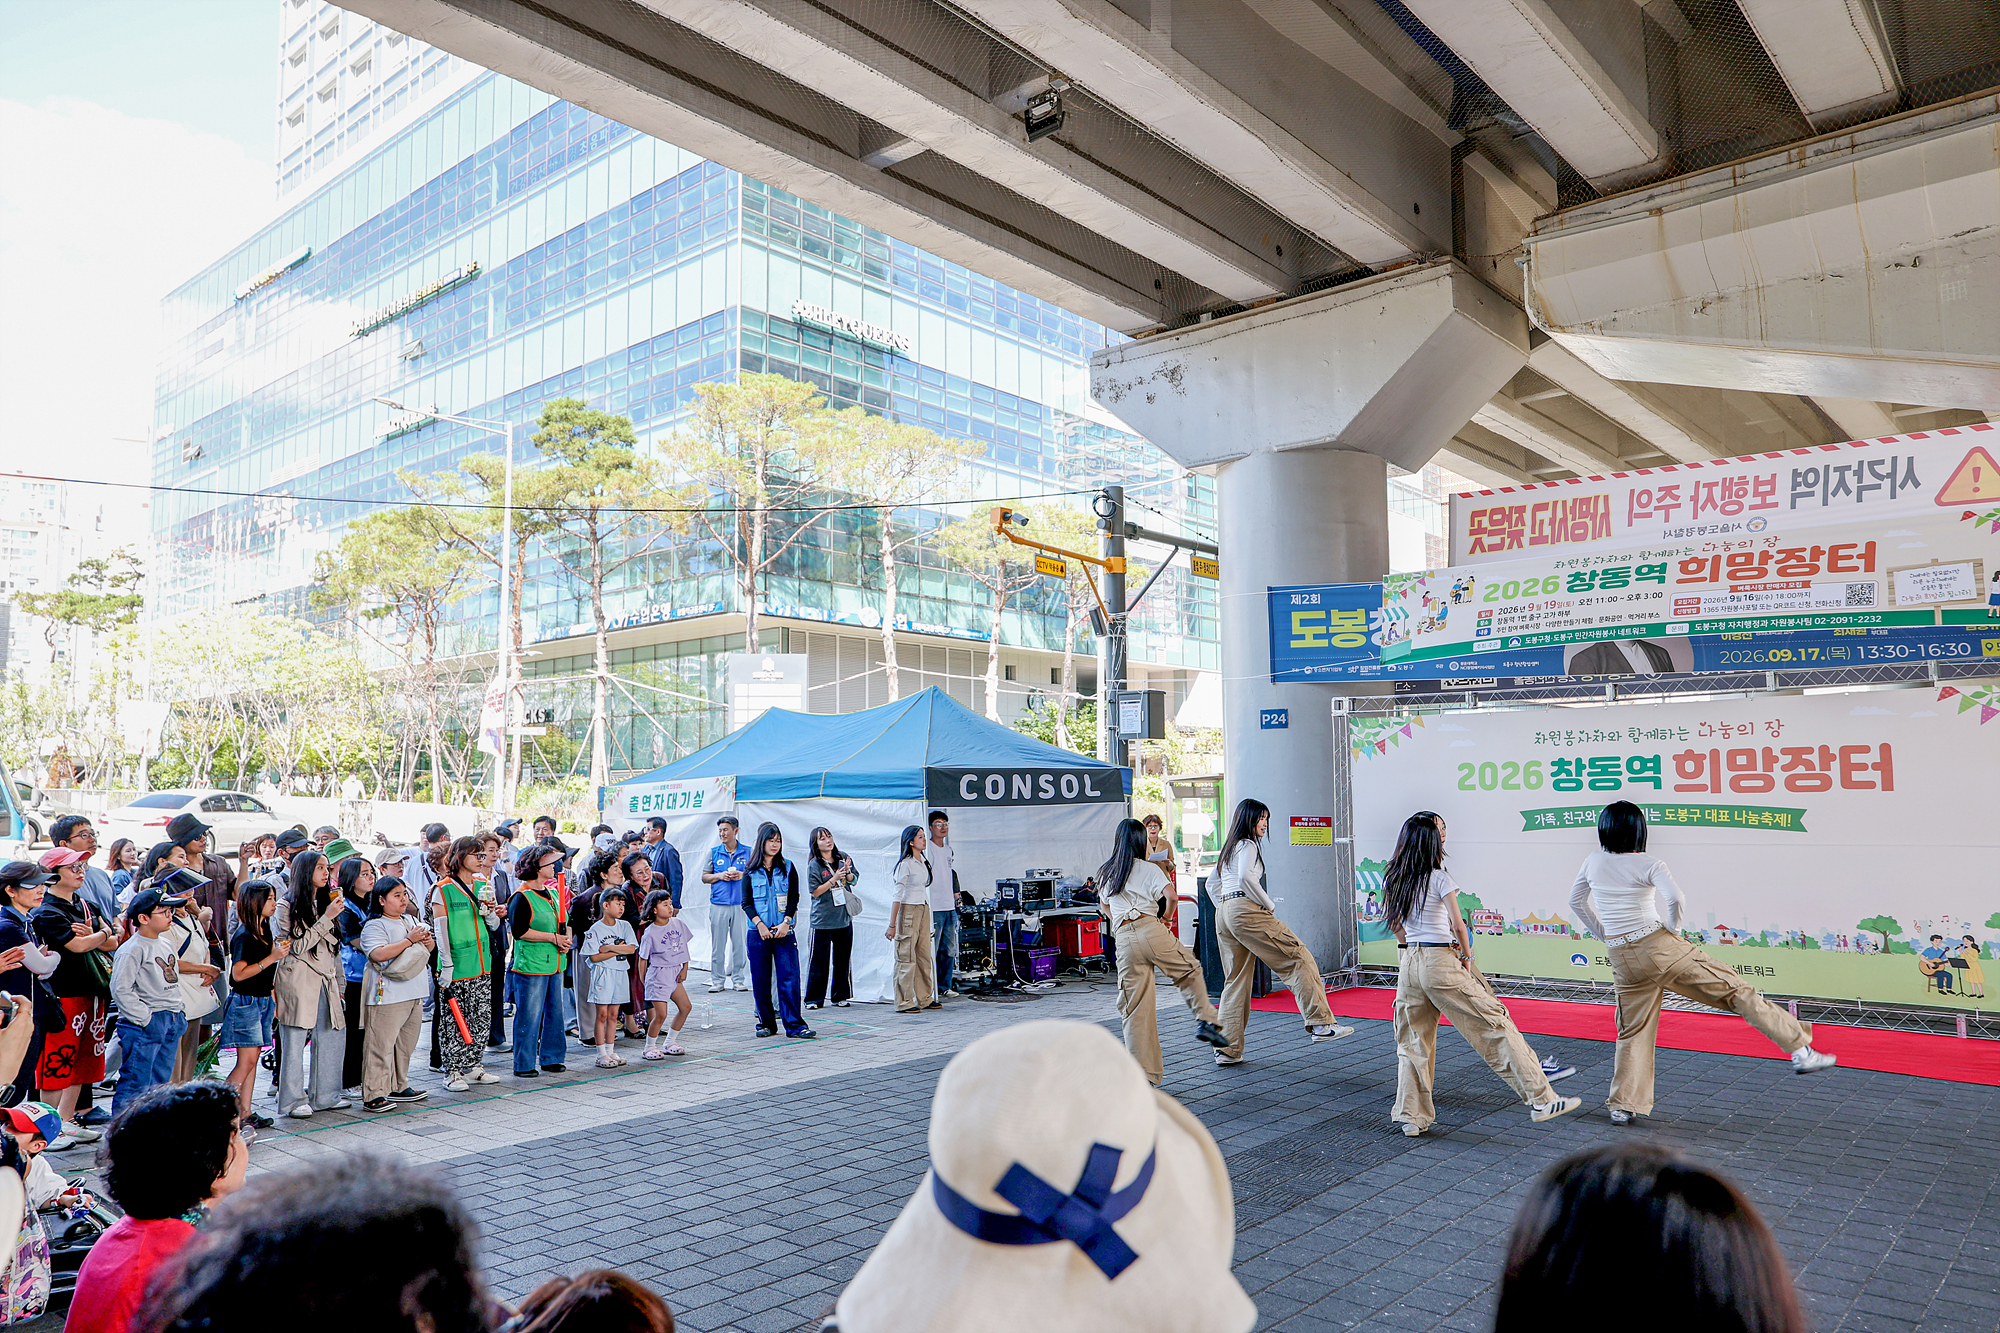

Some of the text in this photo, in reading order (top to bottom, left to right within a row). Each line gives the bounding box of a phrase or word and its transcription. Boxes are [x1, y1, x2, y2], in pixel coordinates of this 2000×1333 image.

[850, 318, 911, 352] QUEENS
[1639, 546, 1695, 561] 함께하는
[1702, 540, 1753, 552] 나눔의
[1763, 536, 1781, 547] 장
[1483, 541, 1877, 602] 2026 창동역 희망장터
[1290, 593, 1321, 605] 제2회
[1498, 606, 1526, 615] 2026년
[1528, 603, 1542, 612] 9월
[1543, 600, 1575, 610] 19일(토)
[1578, 598, 1593, 607] 오전
[1596, 596, 1618, 604] 11:00
[1627, 593, 1642, 601] 오후
[1643, 592, 1663, 600] 3:00
[1703, 592, 1811, 604] 2026년 9월 16일(수) 18:00까지
[1773, 601, 1796, 609] QR코드
[1814, 599, 1842, 608] 전화신청
[629, 602, 671, 625] 수협은행
[1497, 616, 1515, 625] 창동역
[1543, 611, 1556, 619] 고가
[1557, 610, 1571, 618] 하부
[1694, 615, 1882, 631] 도봉구청 자치행정과 자원봉사팀 02-2091-2232
[1575, 629, 1616, 640] 민간자원봉사
[1617, 626, 1647, 637] 네트워크
[1720, 642, 1972, 664] 2026.09.17.(목) 13:30-16:30
[1262, 713, 1286, 725] P24
[1628, 725, 1690, 743] 함께하는
[1698, 721, 1754, 739] 나눔의
[1764, 718, 1785, 738] 장
[1458, 742, 1895, 793] 2026 창동역 희망장터
[959, 773, 1101, 800] CONSOL
[629, 790, 704, 813] 출연자대기실
[1535, 813, 1561, 827] 가족,
[1563, 811, 1597, 825] 친구와
[1664, 808, 1701, 823] 도봉구
[1705, 809, 1730, 823] 대표
[1734, 810, 1792, 827] 나눔축제!
[661, 929, 682, 945] KUROMI
